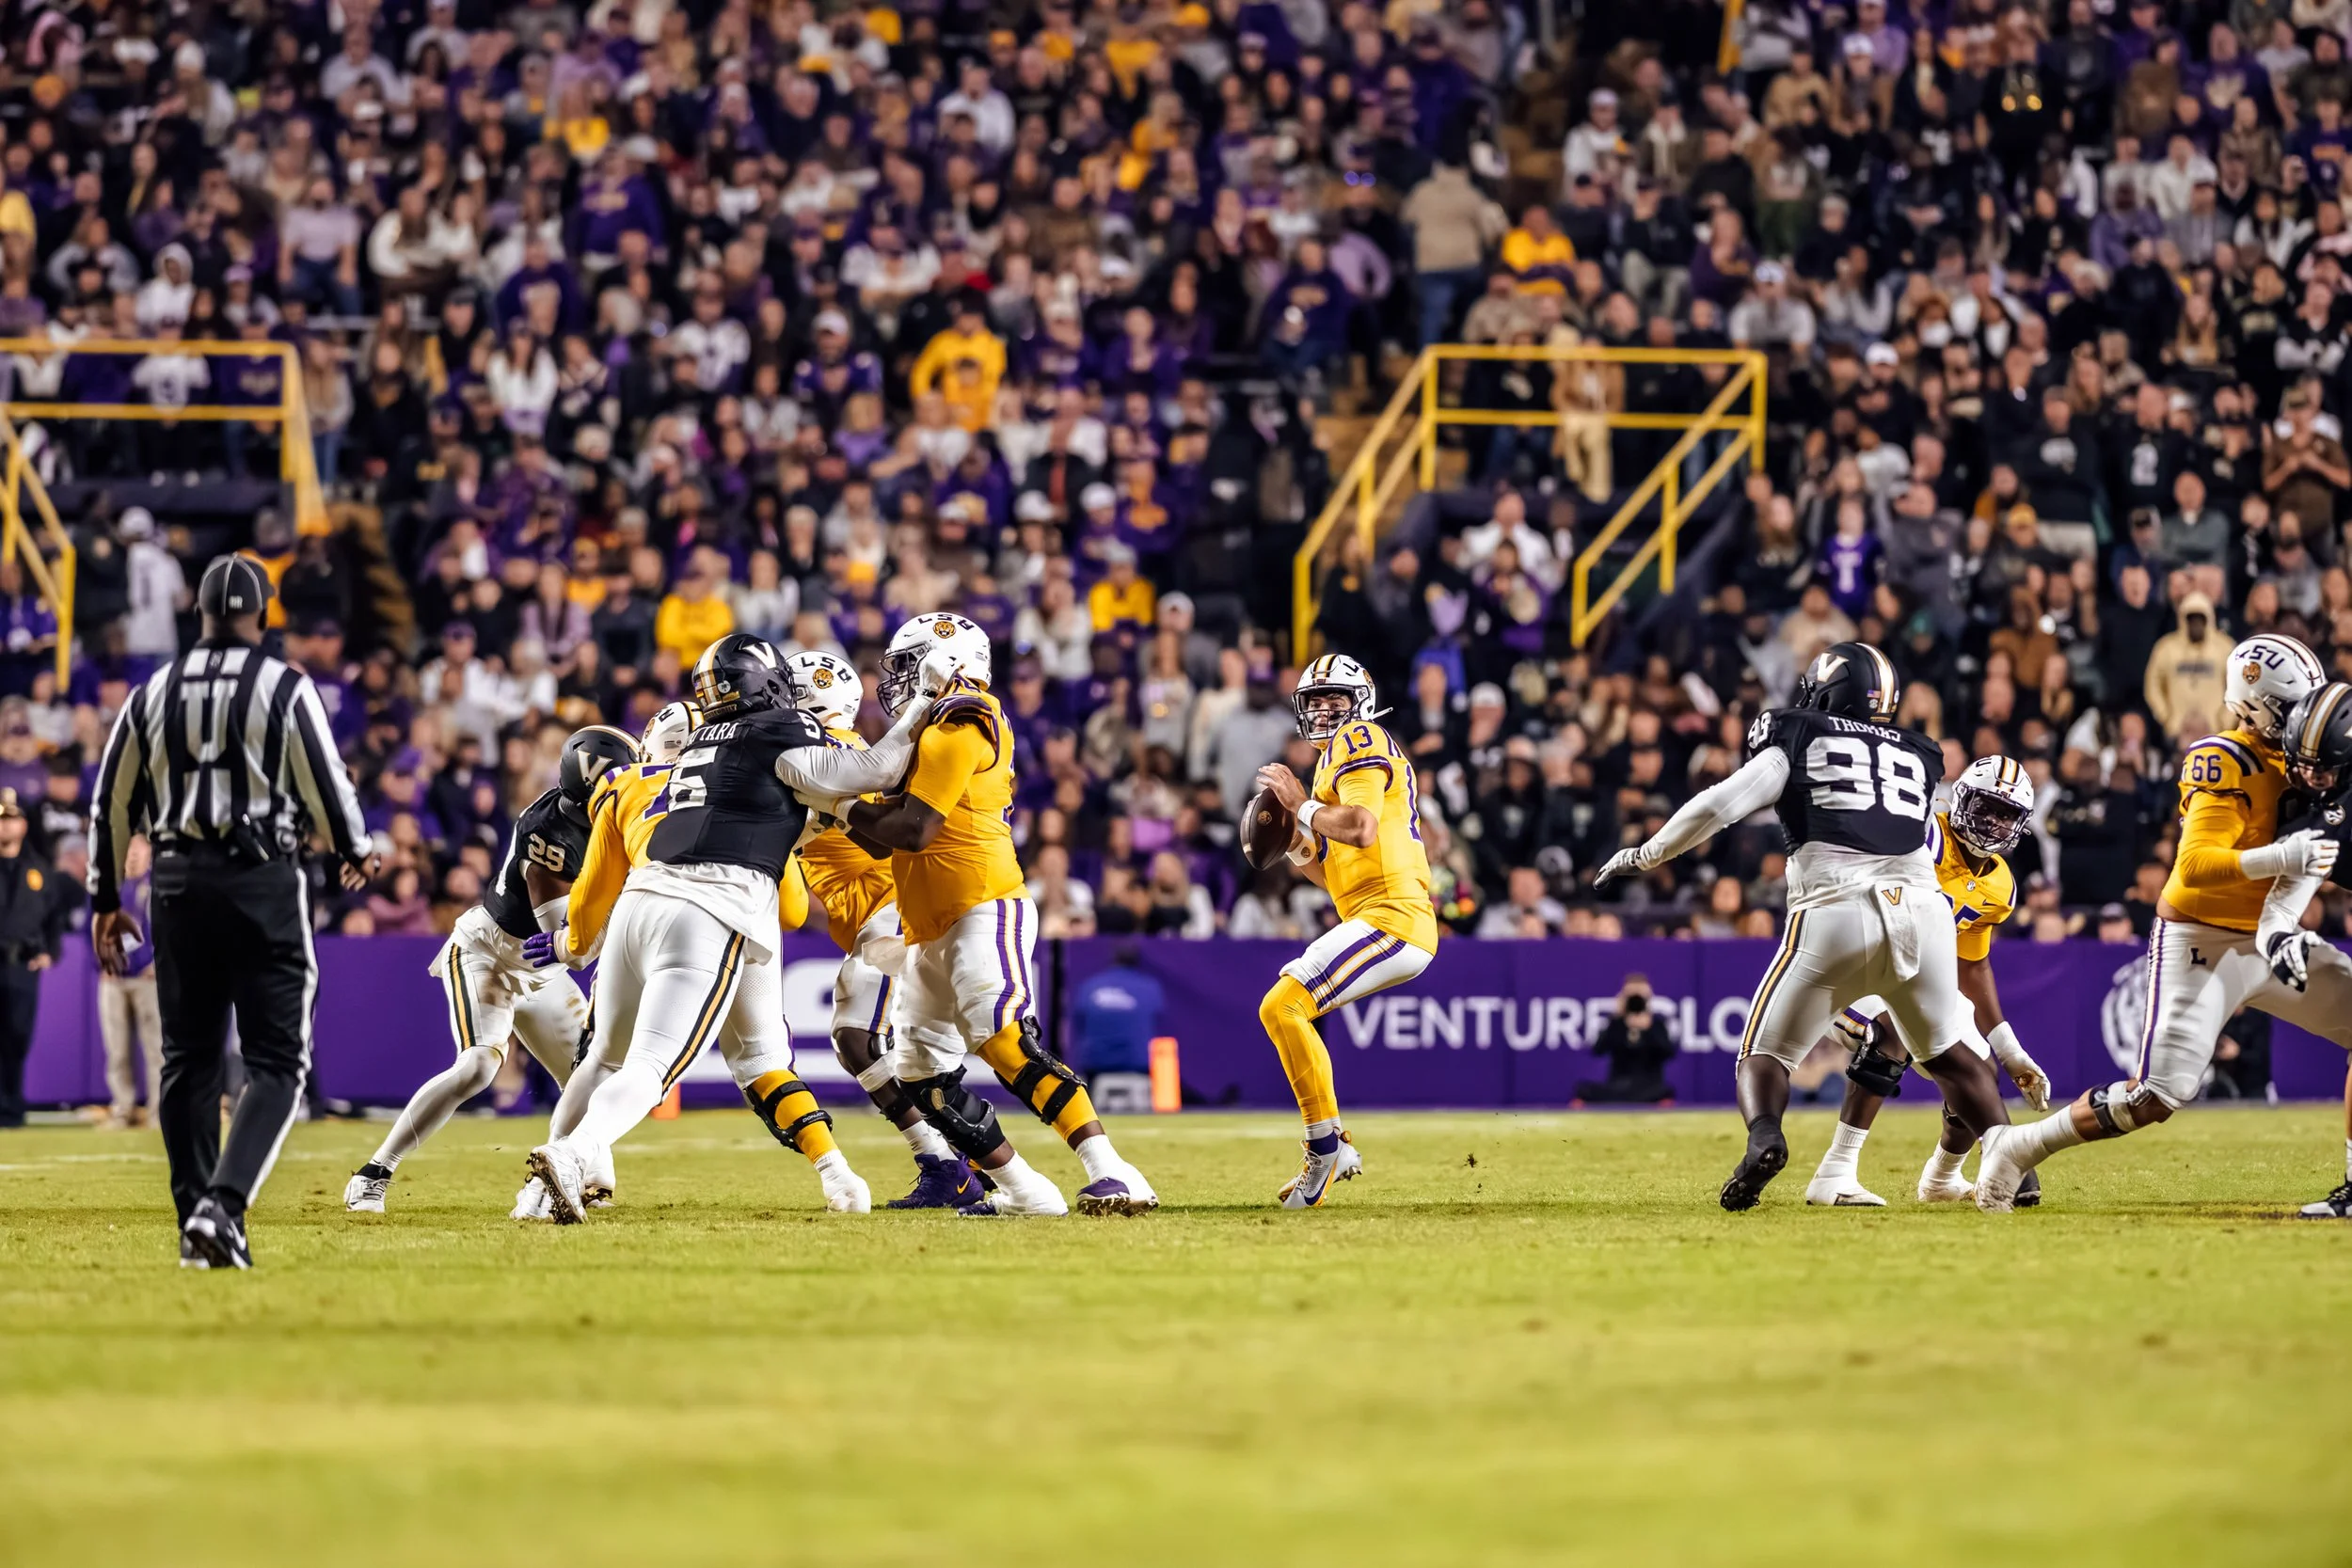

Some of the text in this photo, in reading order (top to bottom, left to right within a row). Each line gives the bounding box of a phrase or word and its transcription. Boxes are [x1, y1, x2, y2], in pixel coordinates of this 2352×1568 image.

[918, 613, 975, 630] LSU
[801, 657, 852, 685] LSU
[1343, 724, 1374, 755] 13
[1806, 736, 1926, 821] 98
[2192, 754, 2223, 783] 66
[528, 833, 565, 872] 29
